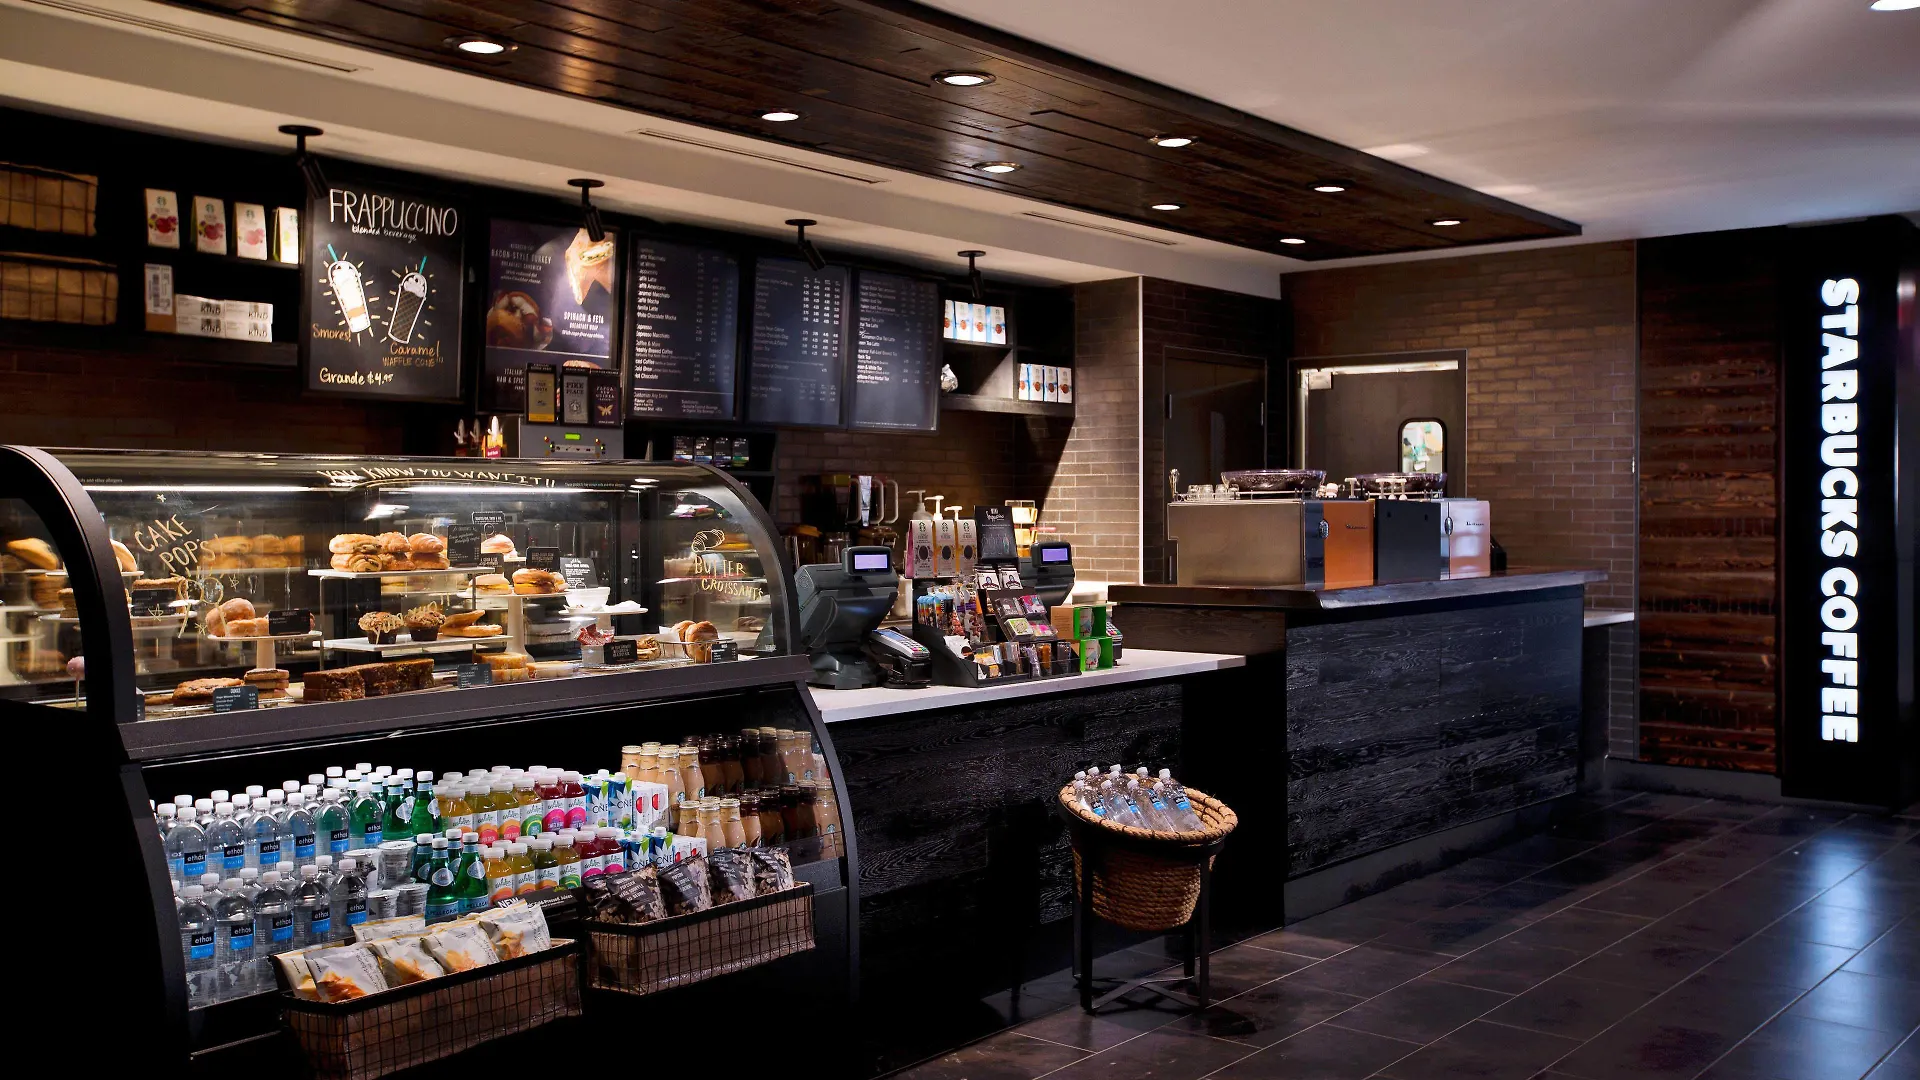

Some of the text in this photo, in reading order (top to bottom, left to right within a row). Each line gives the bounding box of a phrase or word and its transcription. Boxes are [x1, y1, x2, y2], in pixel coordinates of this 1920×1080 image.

[329, 188, 458, 237] FRAPPUCCINO
[352, 224, 381, 236] blended
[531, 254, 552, 265] TURKEY
[564, 311, 586, 322] SPINACH
[593, 314, 604, 325] FETA
[390, 340, 440, 357] Caramel
[382, 356, 412, 368] WAFFLE
[319, 367, 366, 385] Grande
[566, 381, 584, 390] PIKE
[316, 470, 355, 485] YOU
[361, 466, 415, 480] KNOW
[417, 467, 452, 478] YOU
[454, 470, 516, 482] WANT
[1820, 277, 1859, 743] STARBUCKS COFFEE
[134, 513, 193, 553] CAKE
[159, 540, 217, 573] POPS
[695, 555, 747, 579] BUTTER
[701, 578, 764, 601] CROISSANTS
[367, 824, 381, 832] ethos
[333, 831, 348, 839] ethos
[298, 837, 314, 846] ethos
[226, 847, 243, 856] ethos
[263, 844, 280, 852] ethos
[187, 852, 206, 862] ethos
[350, 903, 366, 912] ethos
[497, 896, 519, 908] NEW
[315, 909, 331, 919] ethos
[275, 917, 293, 927] ethos
[234, 926, 253, 936] ethos
[194, 934, 213, 945] ethos
